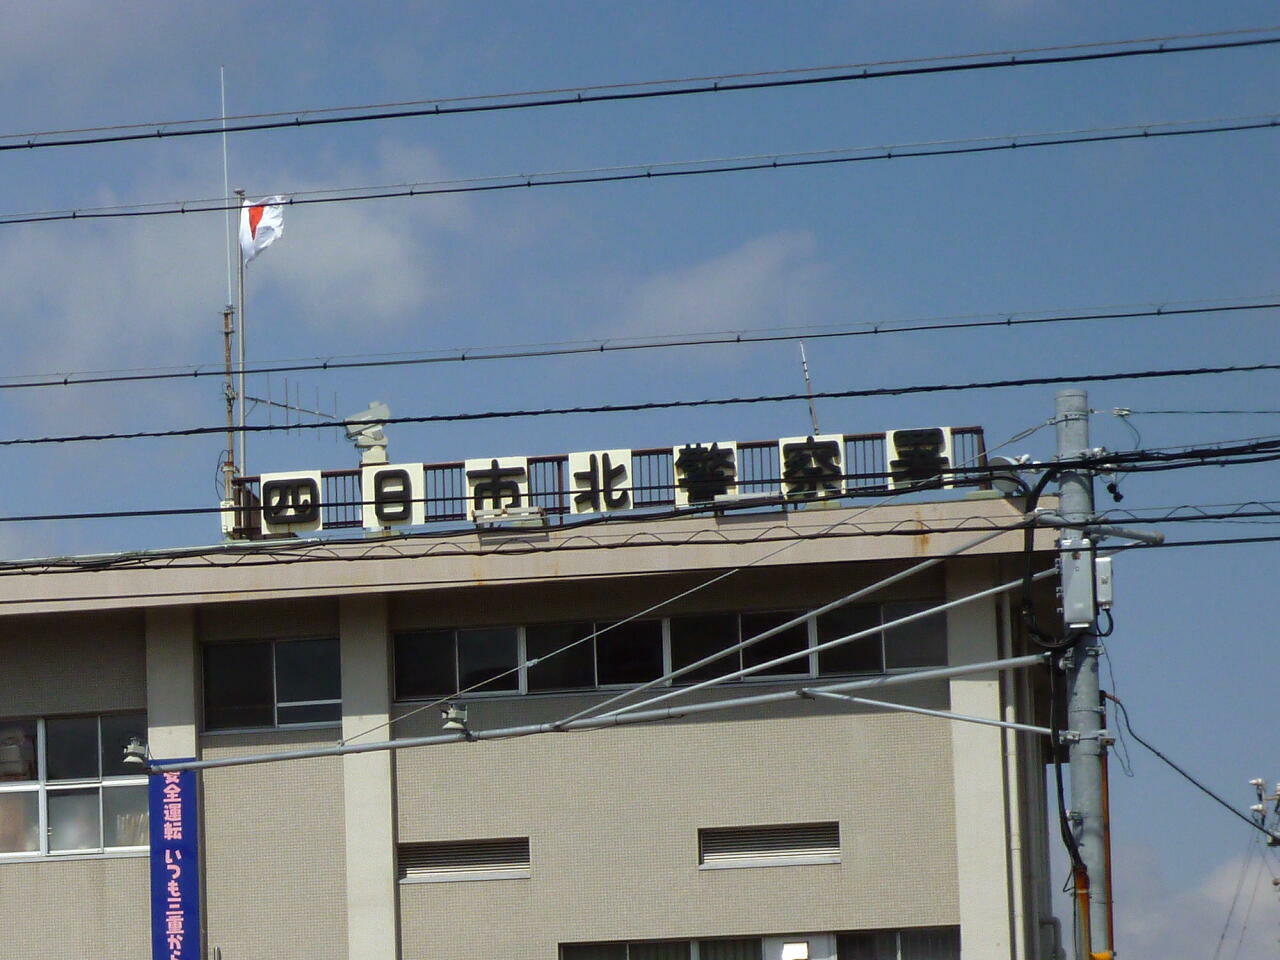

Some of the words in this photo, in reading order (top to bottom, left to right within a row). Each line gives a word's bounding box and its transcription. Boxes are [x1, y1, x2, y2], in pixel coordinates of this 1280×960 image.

[263, 428, 948, 524] 四日市北警察署
